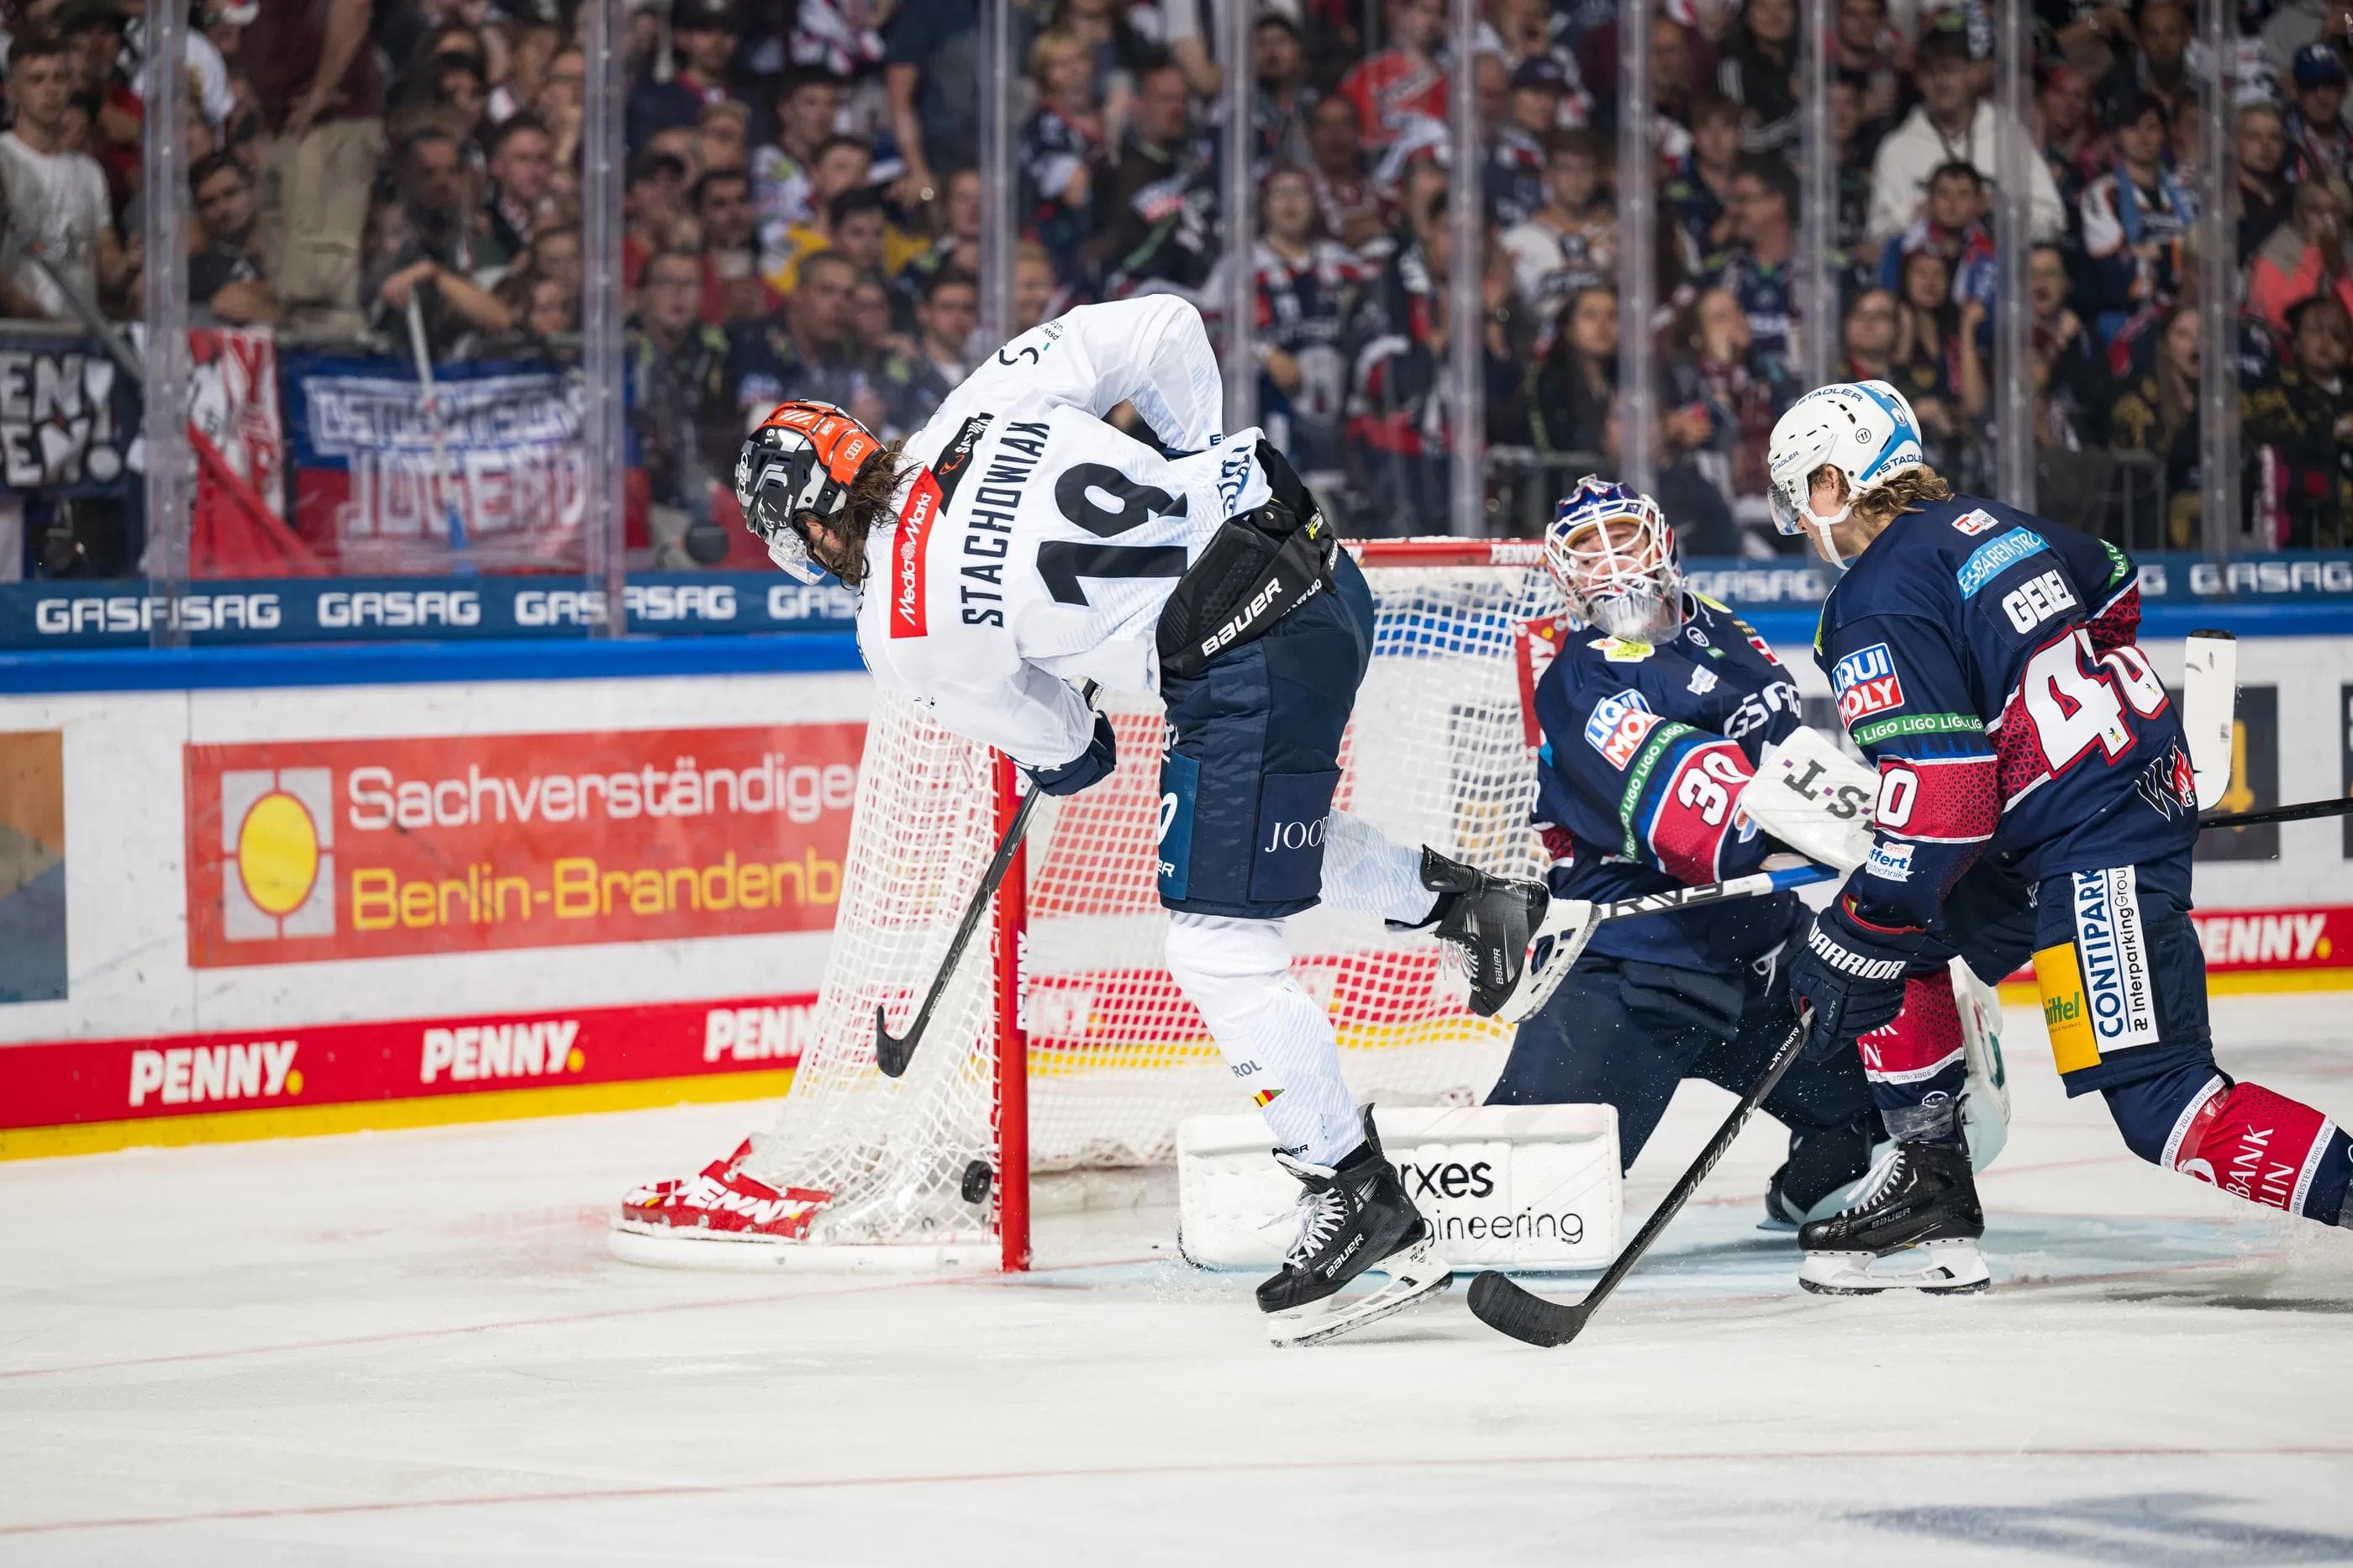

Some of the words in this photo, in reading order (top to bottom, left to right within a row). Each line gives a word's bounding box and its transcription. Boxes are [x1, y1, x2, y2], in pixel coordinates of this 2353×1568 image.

[1796, 387, 1864, 407] STADLER
[766, 429, 775, 444] 19
[1772, 450, 1800, 473] STADLER
[961, 422, 1050, 629] STACHOWIAK
[1036, 461, 1187, 608] 19
[898, 492, 933, 627] MediaMarkt
[2189, 561, 2353, 597] GASAG
[318, 591, 482, 628] GASAG
[1201, 577, 1283, 658] BAUER
[1863, 721, 1898, 742] LIGO
[1903, 716, 1936, 732] LIGO
[1625, 778, 1641, 812] LIGO
[1636, 745, 1661, 777] LIGO
[1660, 724, 1685, 745] LIGO
[1678, 751, 1752, 827] 30
[1493, 948, 1504, 986] BAUER
[2077, 869, 2124, 1039] CONTIPARK
[2170, 1130, 2182, 1149] 2013
[2179, 1111, 2193, 1130] 2021
[2225, 1123, 2274, 1200] BANK
[2295, 1167, 2313, 1197] MEISTER
[2309, 1145, 2324, 1165] 2005
[2319, 1123, 2334, 1144] 2006
[1871, 1207, 1912, 1229] BAUER
[1325, 1233, 1366, 1279] BAUER
